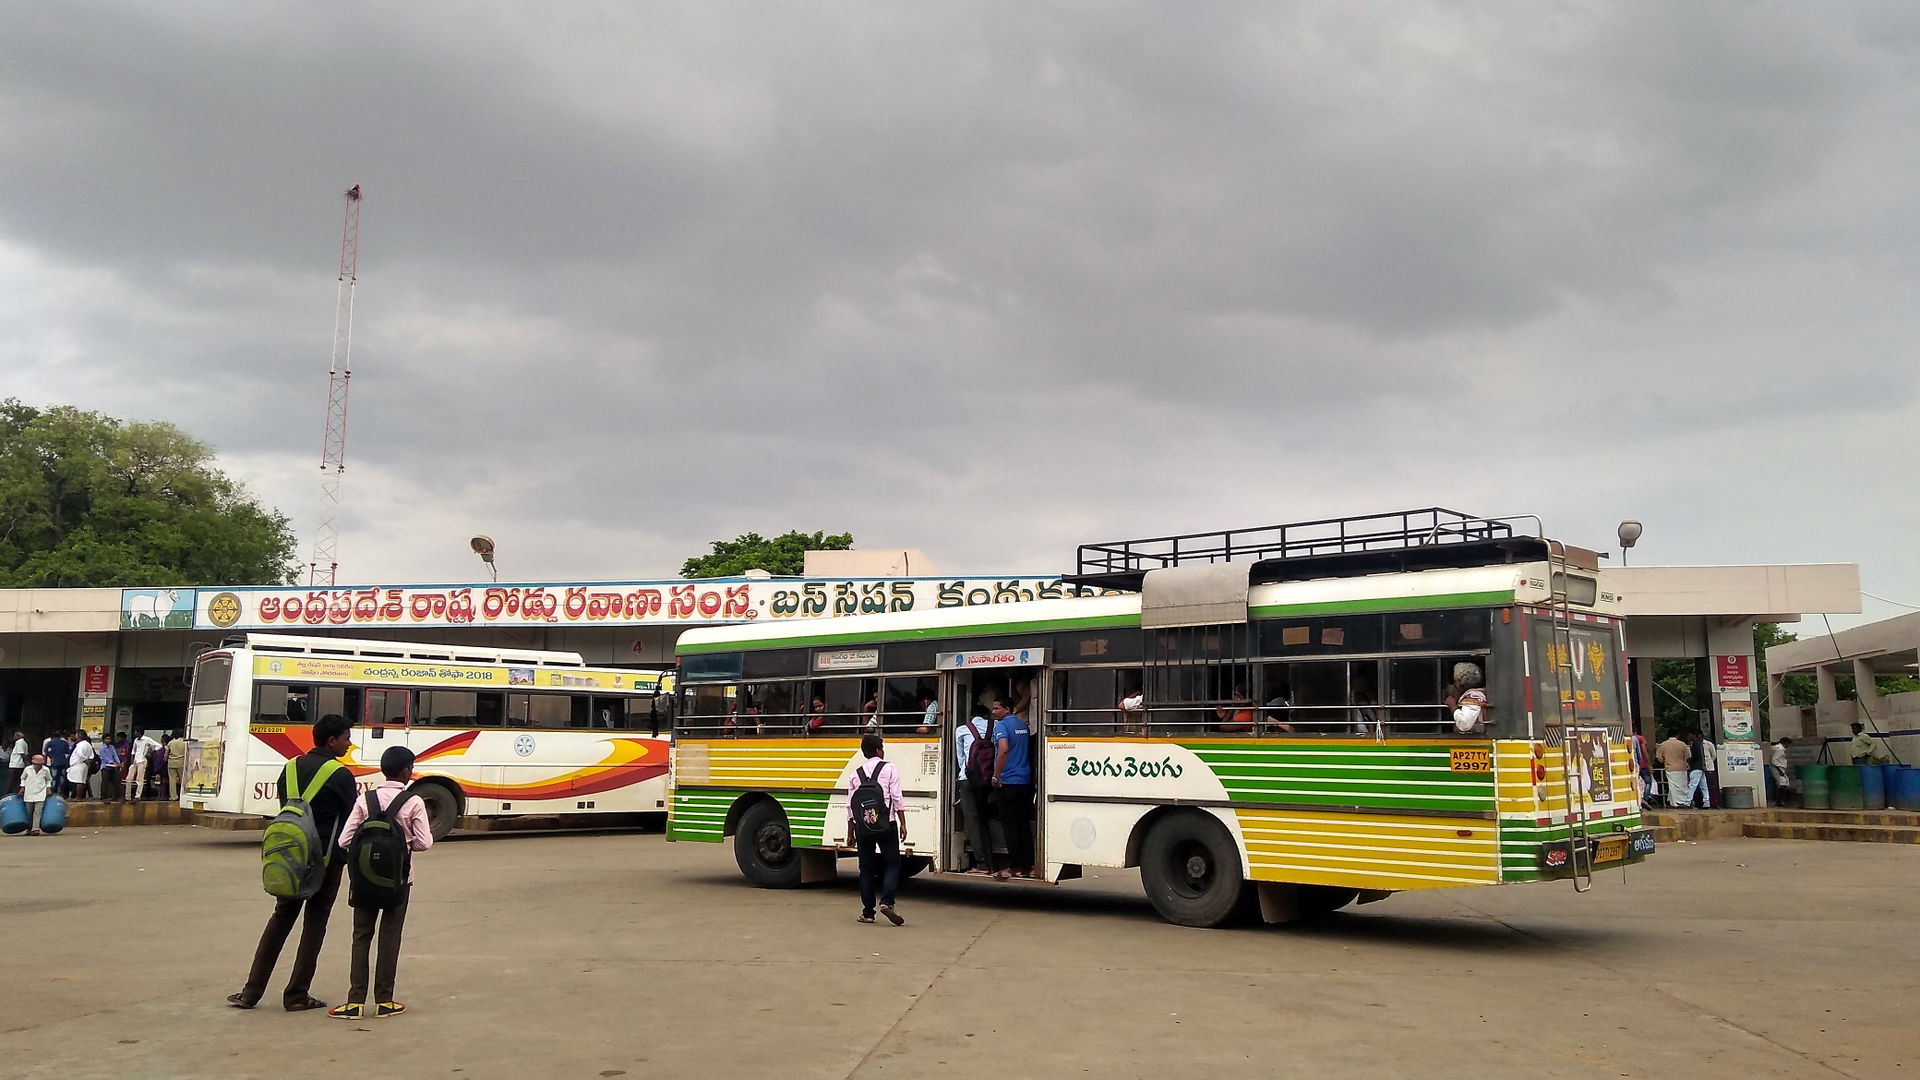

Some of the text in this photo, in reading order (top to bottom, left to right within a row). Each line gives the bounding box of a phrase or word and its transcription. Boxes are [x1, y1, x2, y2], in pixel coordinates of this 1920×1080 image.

[482, 587, 558, 622] రోడ్డు
[668, 584, 758, 620] సంస్థ
[769, 582, 826, 617] బస్
[633, 640, 642, 654] 4
[364, 667, 399, 678] చంద్రన్న
[401, 667, 437, 678] రంజాన్
[466, 671, 493, 680] 2018
[1453, 751, 1487, 759] AP27TY
[1067, 756, 1183, 778] తెలుగు వెలుగు
[1454, 762, 1488, 770] 2997
